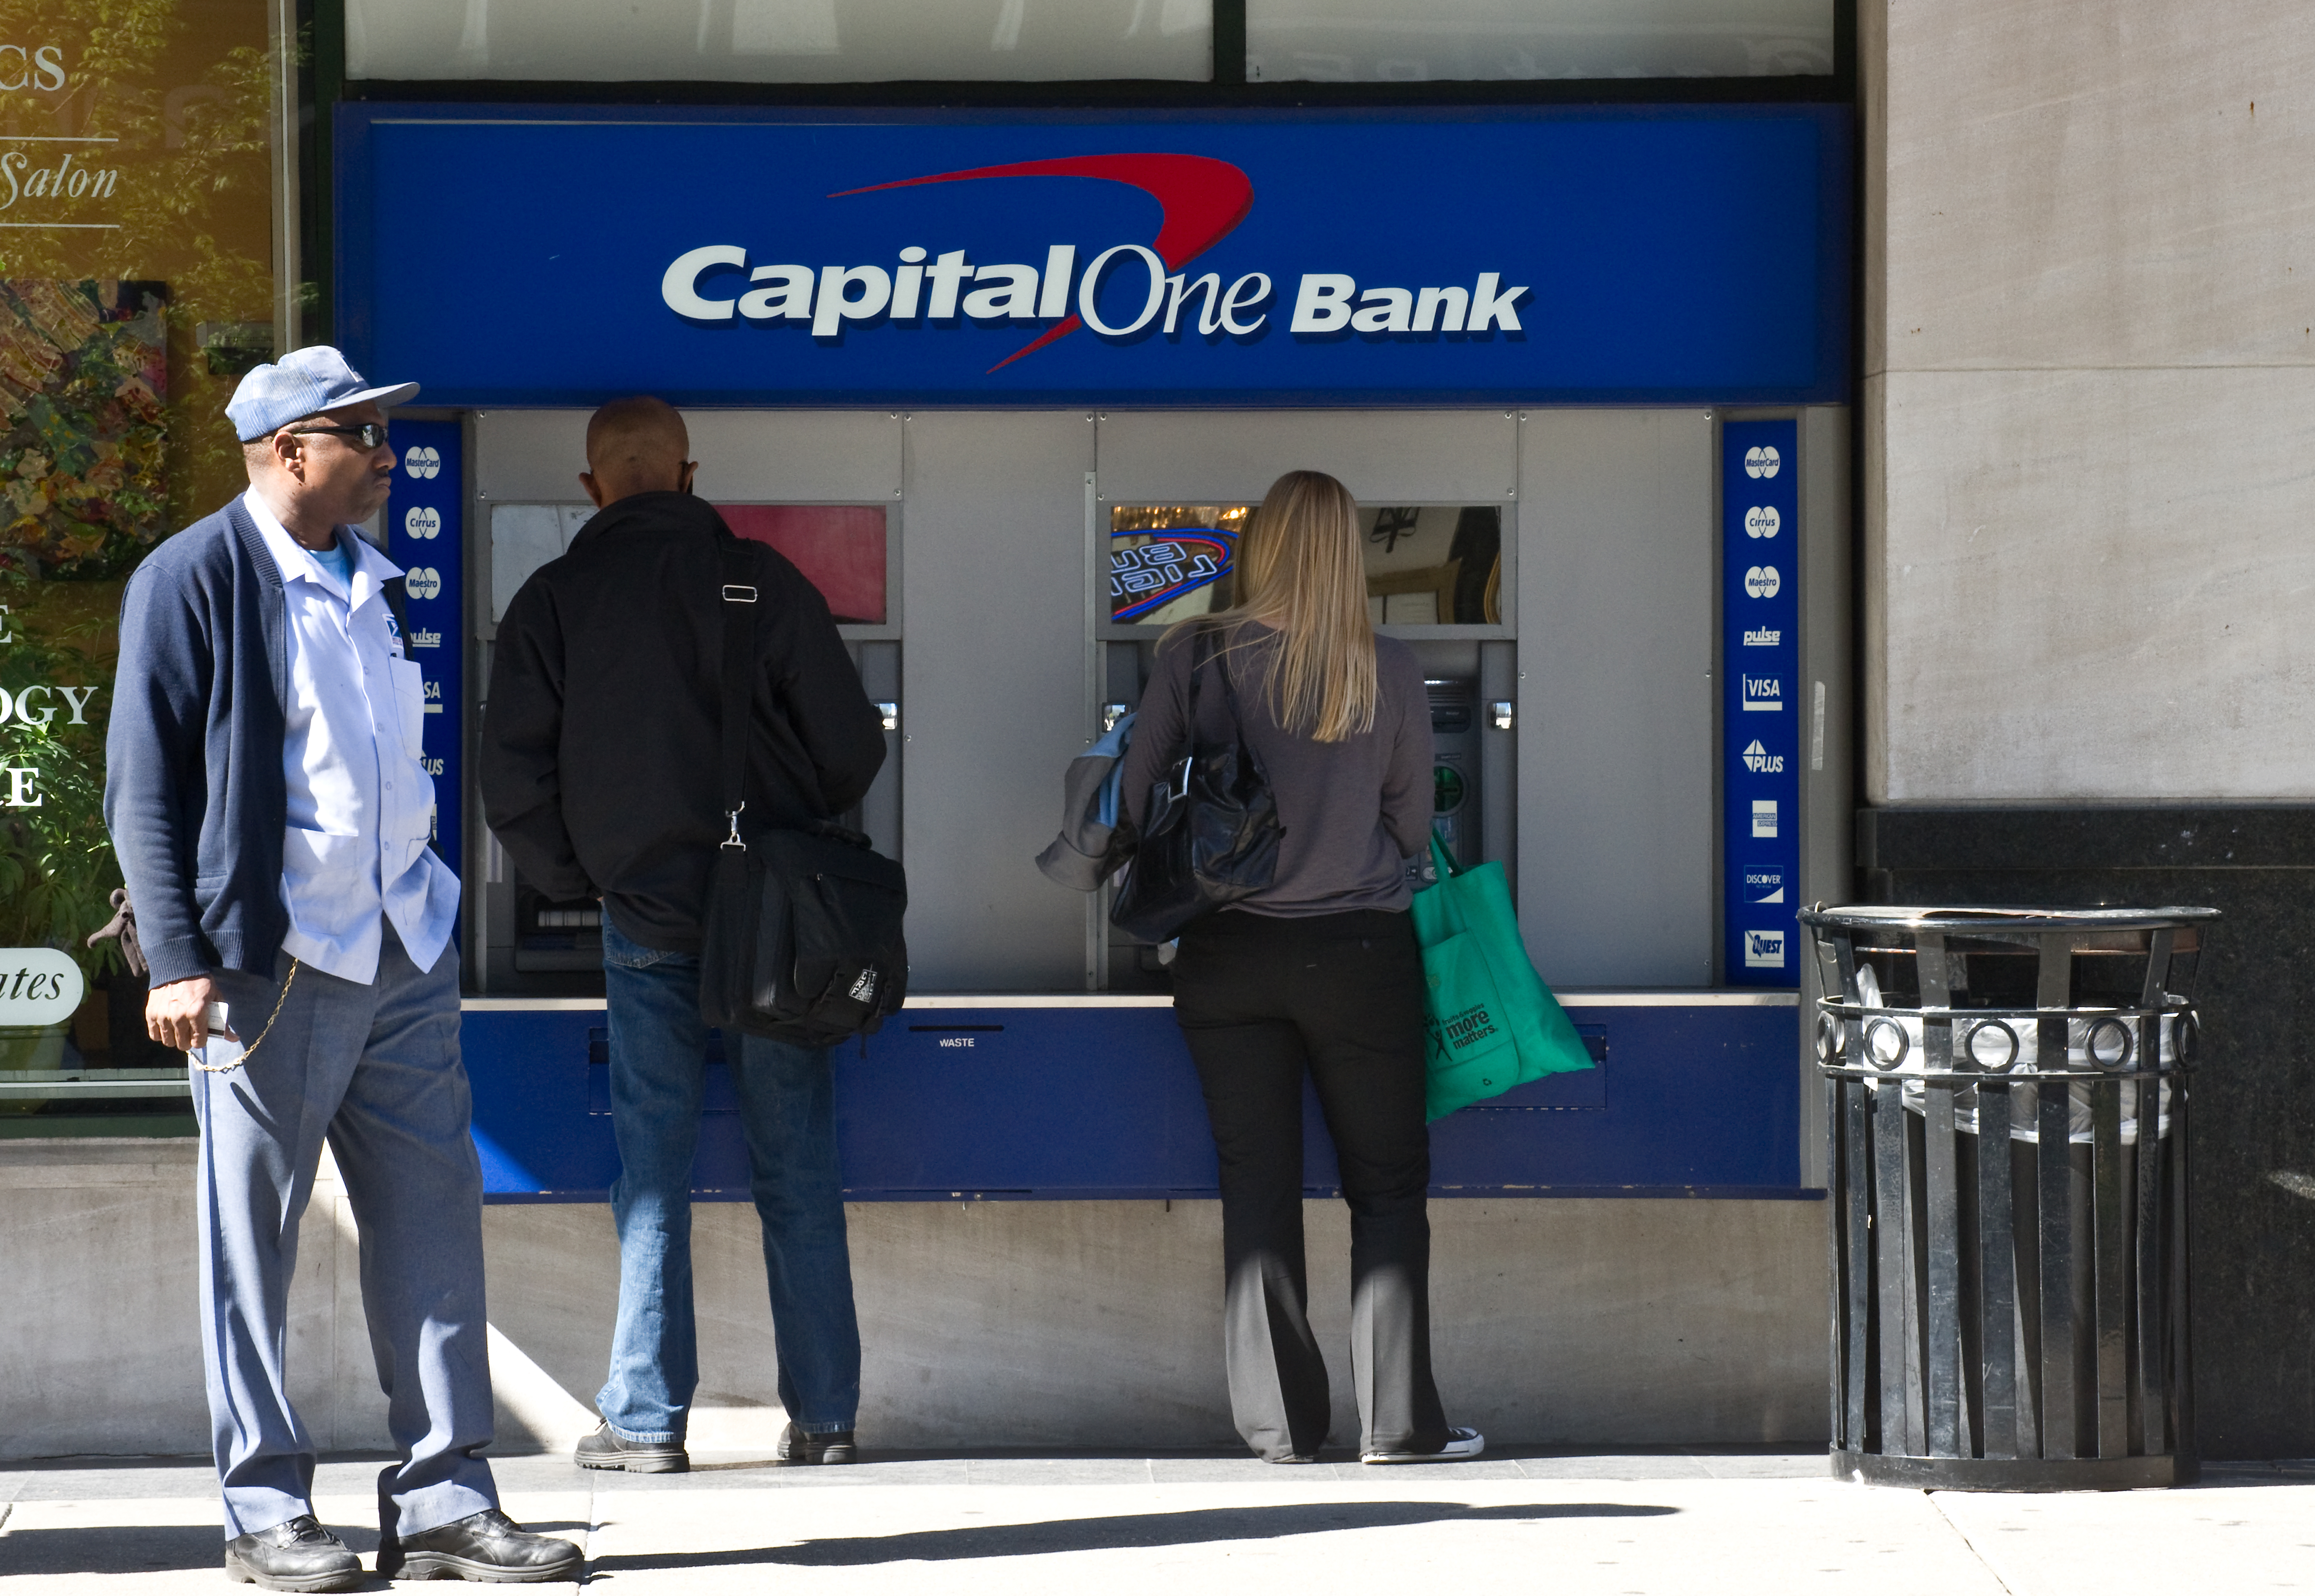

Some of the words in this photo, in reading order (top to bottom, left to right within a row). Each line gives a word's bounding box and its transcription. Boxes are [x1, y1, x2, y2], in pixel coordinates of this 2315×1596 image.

[0, 152, 117, 210] Salon
[1290, 272, 1529, 332] Bank
[406, 458, 439, 467] MasterCard
[1746, 458, 1779, 467] MasterCard
[410, 518, 436, 528] Cirrus
[1749, 518, 1775, 527] Cirrus
[409, 579, 437, 588] Maestro
[1749, 578, 1777, 586] Maestro
[1743, 626, 1780, 646] pulse
[1747, 679, 1780, 697] VISA
[1753, 756, 1784, 773] PLUS
[1746, 874, 1781, 884] DISCOVER
[1752, 934, 1782, 958] QUEST
[1445, 1010, 1490, 1039] more
[940, 1038, 975, 1047] WASTE
